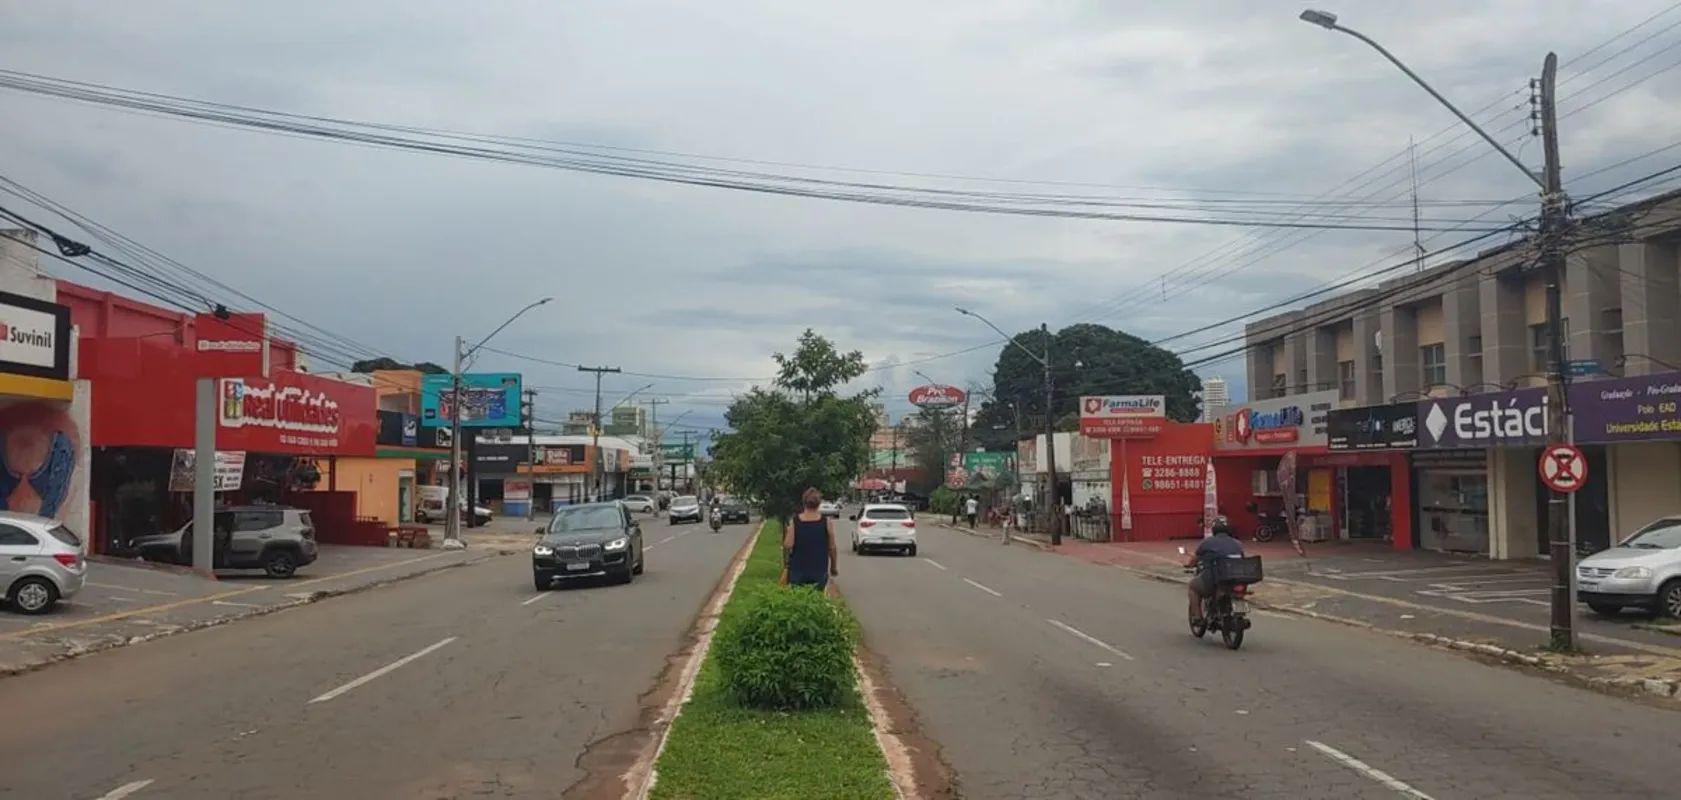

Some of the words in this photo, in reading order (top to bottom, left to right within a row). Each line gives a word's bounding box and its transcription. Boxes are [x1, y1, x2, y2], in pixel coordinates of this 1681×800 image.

[10, 326, 52, 348] Suvinil
[243, 386, 276, 425] Real
[1103, 398, 1160, 408] FarmaLife
[1637, 405, 1655, 414] Polo
[1659, 402, 1677, 413] EAD
[1454, 395, 1549, 439] Estáci
[1606, 422, 1659, 434] Universidade
[1142, 455, 1206, 465] TELE-ENTREGA
